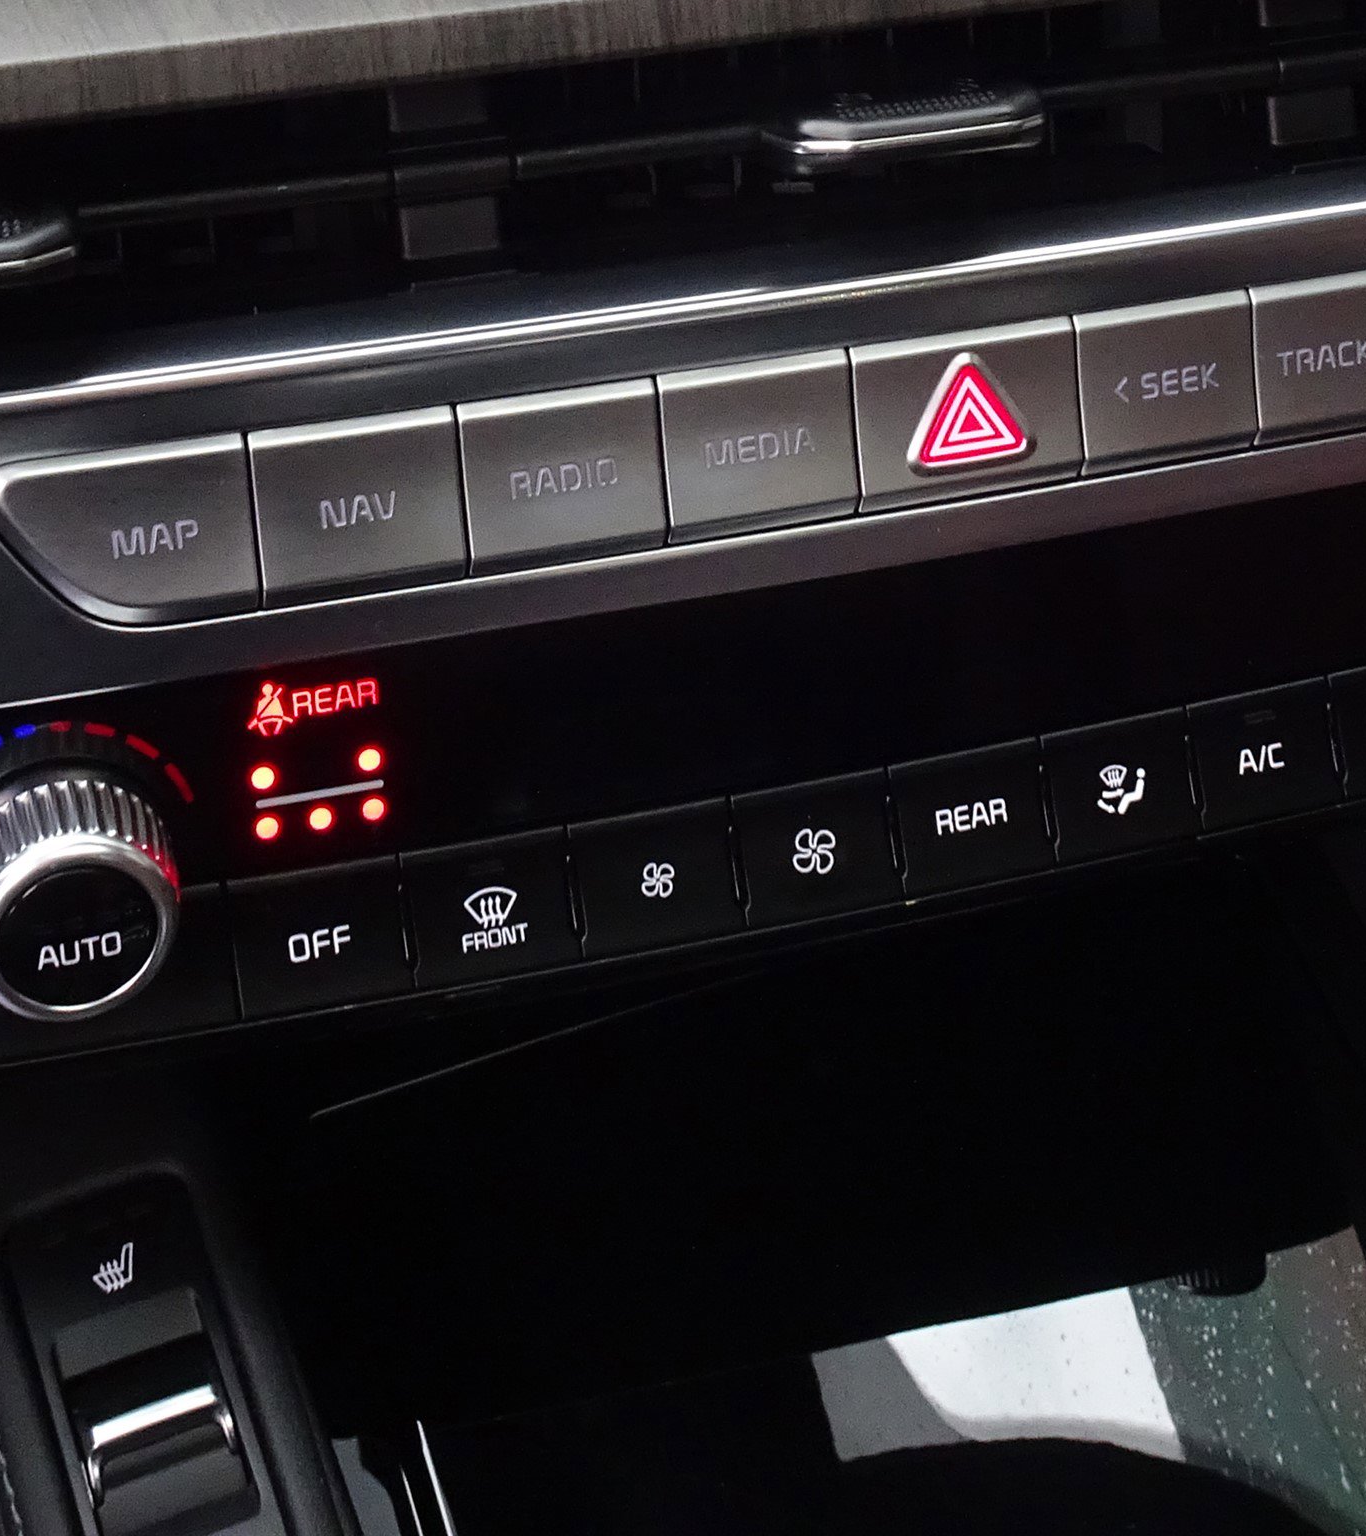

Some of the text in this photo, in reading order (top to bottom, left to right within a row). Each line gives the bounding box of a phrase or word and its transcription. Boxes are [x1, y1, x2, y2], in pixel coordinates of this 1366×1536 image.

[1140, 362, 1219, 401] SEEK
[704, 425, 817, 470] MEDIA
[510, 457, 620, 501] RADIO
[319, 490, 398, 530] NAV
[110, 518, 200, 560] MAP
[291, 680, 378, 716] REAR
[1238, 742, 1286, 775] A/C
[934, 798, 1009, 836] REAR
[36, 930, 124, 972] AUTO
[287, 924, 352, 964] OFF
[461, 922, 529, 955] FRONT
